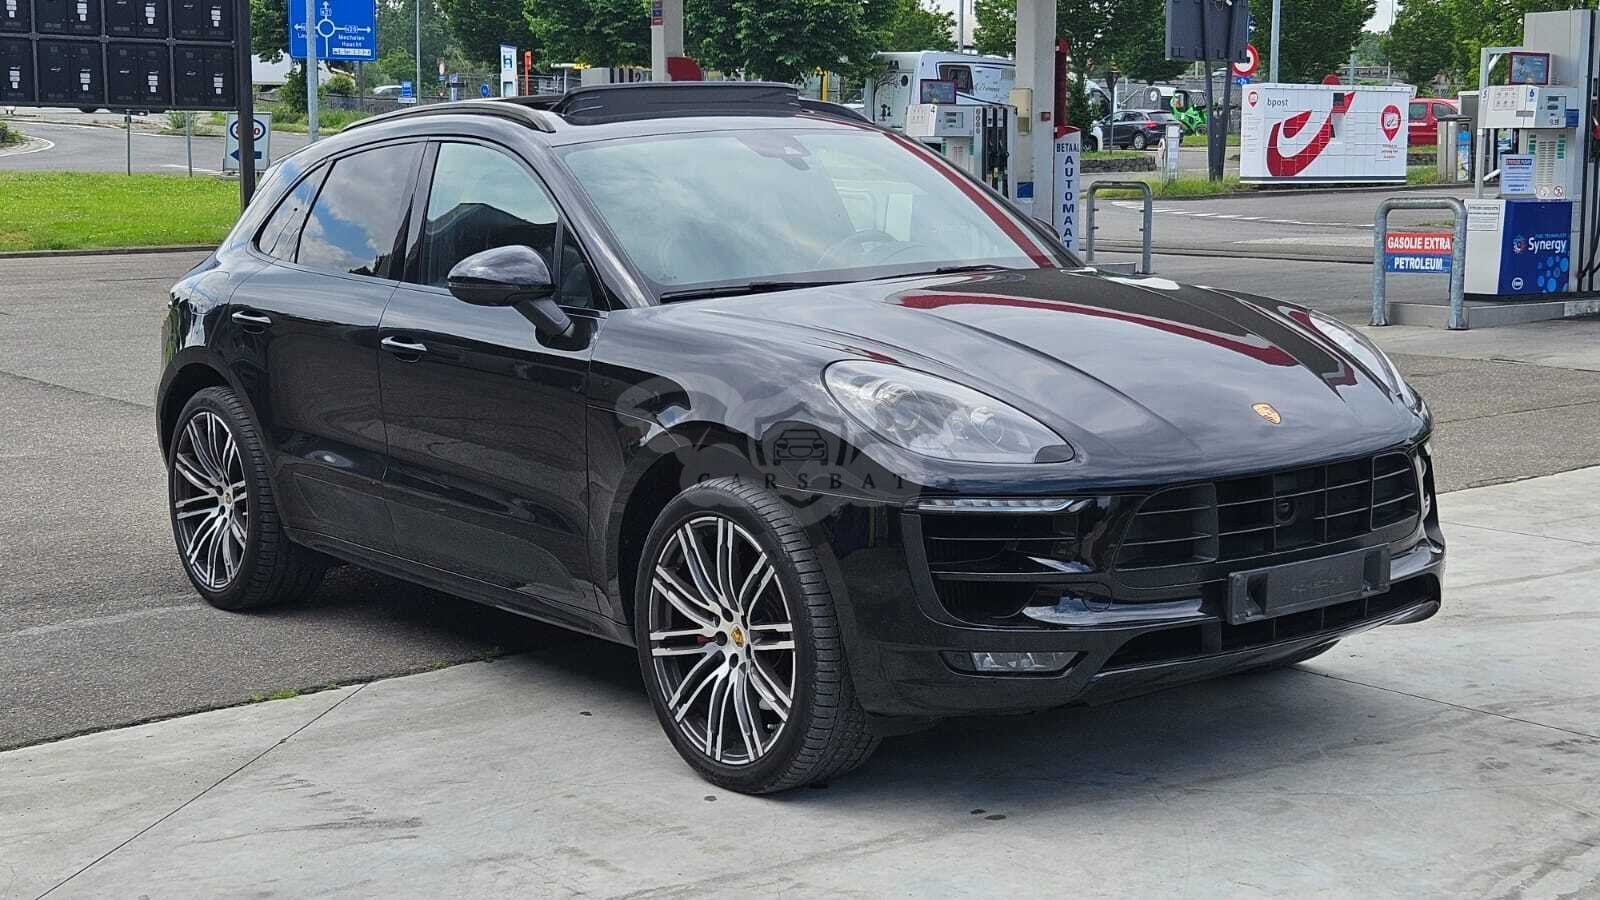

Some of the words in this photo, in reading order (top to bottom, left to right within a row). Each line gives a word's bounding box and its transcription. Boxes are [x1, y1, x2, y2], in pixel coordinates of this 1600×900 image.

[1267, 98, 1288, 107] bpost
[1056, 143, 1080, 153] BETAAL
[1062, 155, 1075, 249] AUTOMAAT
[1387, 236, 1423, 249] GASOLIE
[1424, 237, 1451, 250] EXTRA
[1528, 236, 1567, 254] Synergy
[1394, 256, 1443, 271] PETROLEUM
